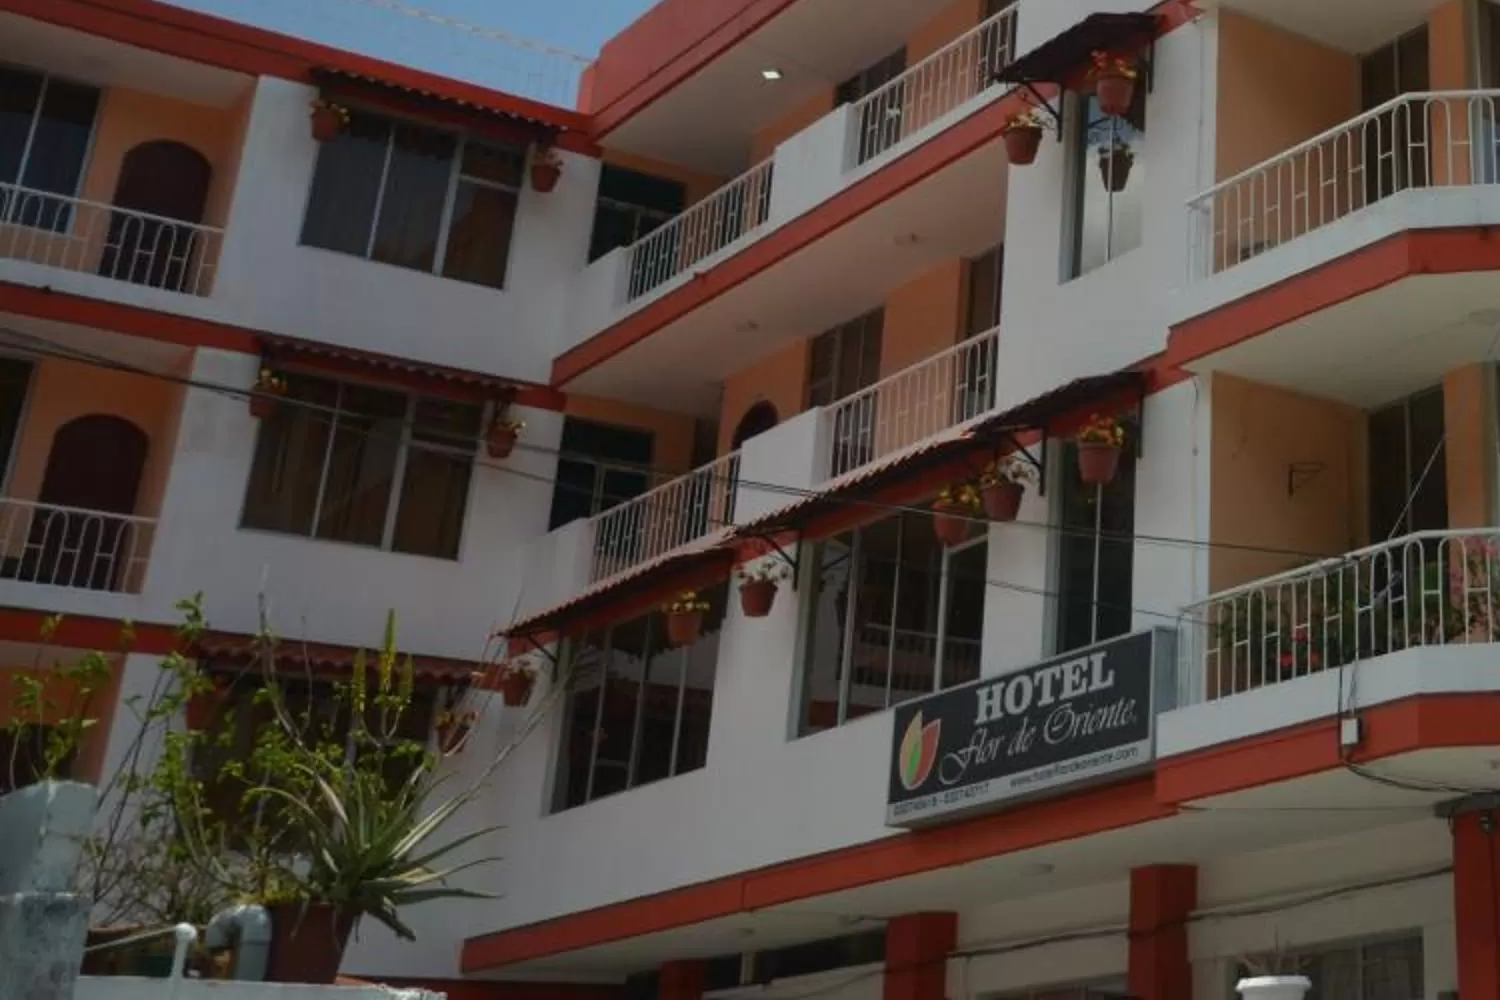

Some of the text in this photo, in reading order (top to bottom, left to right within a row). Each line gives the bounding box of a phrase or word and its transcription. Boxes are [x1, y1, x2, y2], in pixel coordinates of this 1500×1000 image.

[975, 651, 1116, 725] HOTEL
[939, 698, 1137, 785] Flor de Oriente
